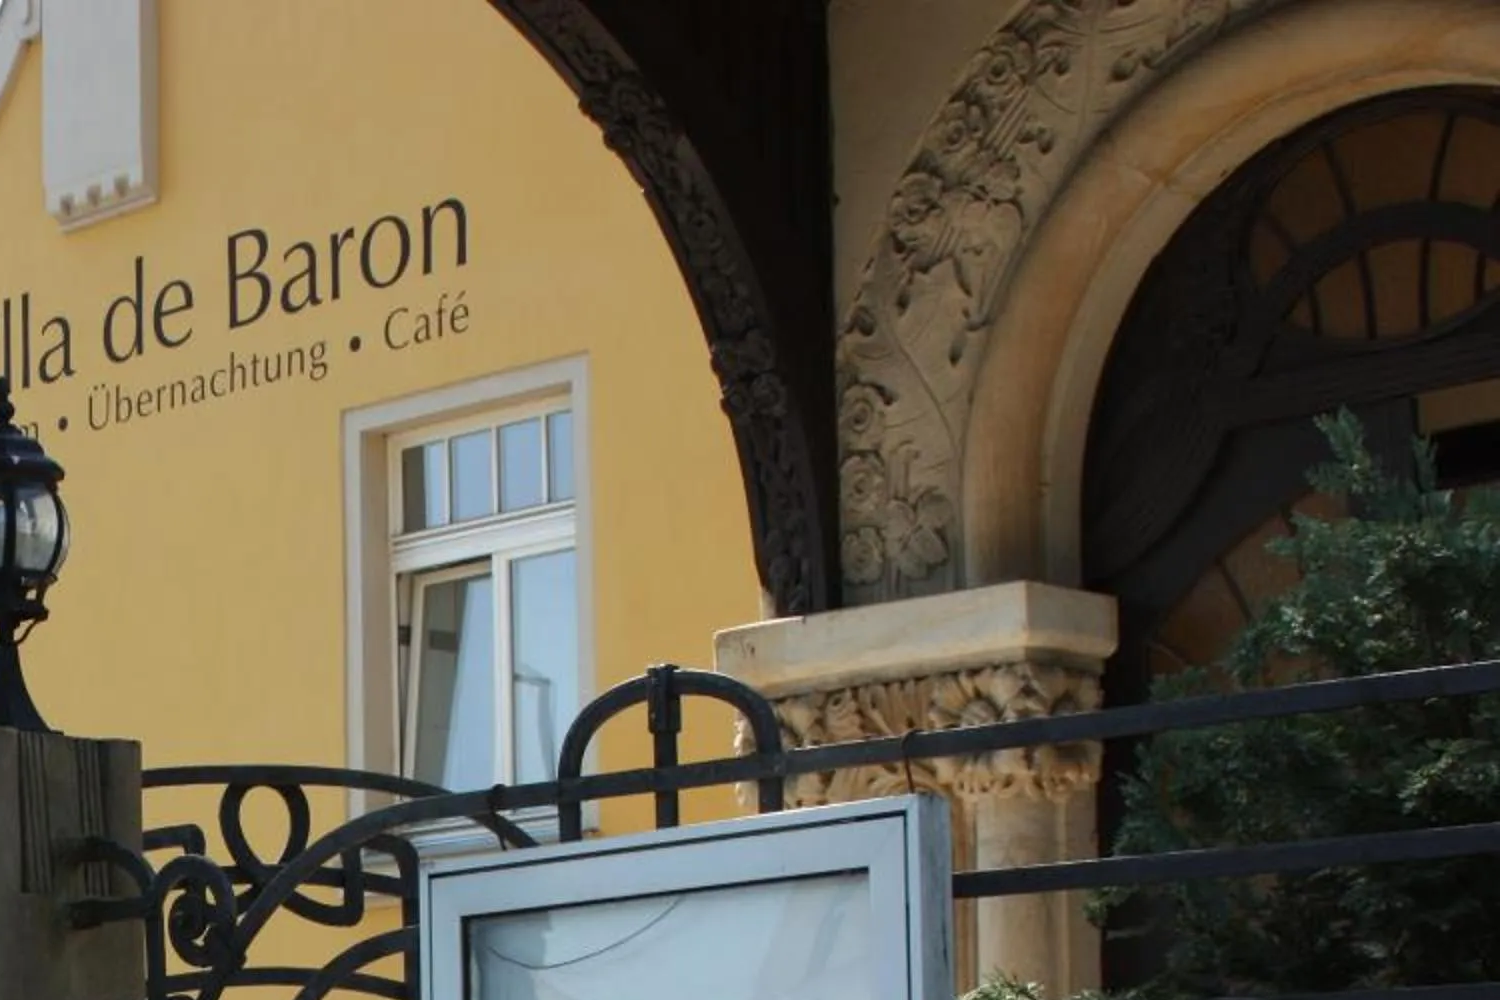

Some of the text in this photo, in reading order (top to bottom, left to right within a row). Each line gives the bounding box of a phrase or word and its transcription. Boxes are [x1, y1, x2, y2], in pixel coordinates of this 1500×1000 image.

[102, 256, 194, 364] de
[227, 196, 468, 330] Baron
[88, 338, 328, 432] Übernachtung
[383, 291, 471, 351] Café
